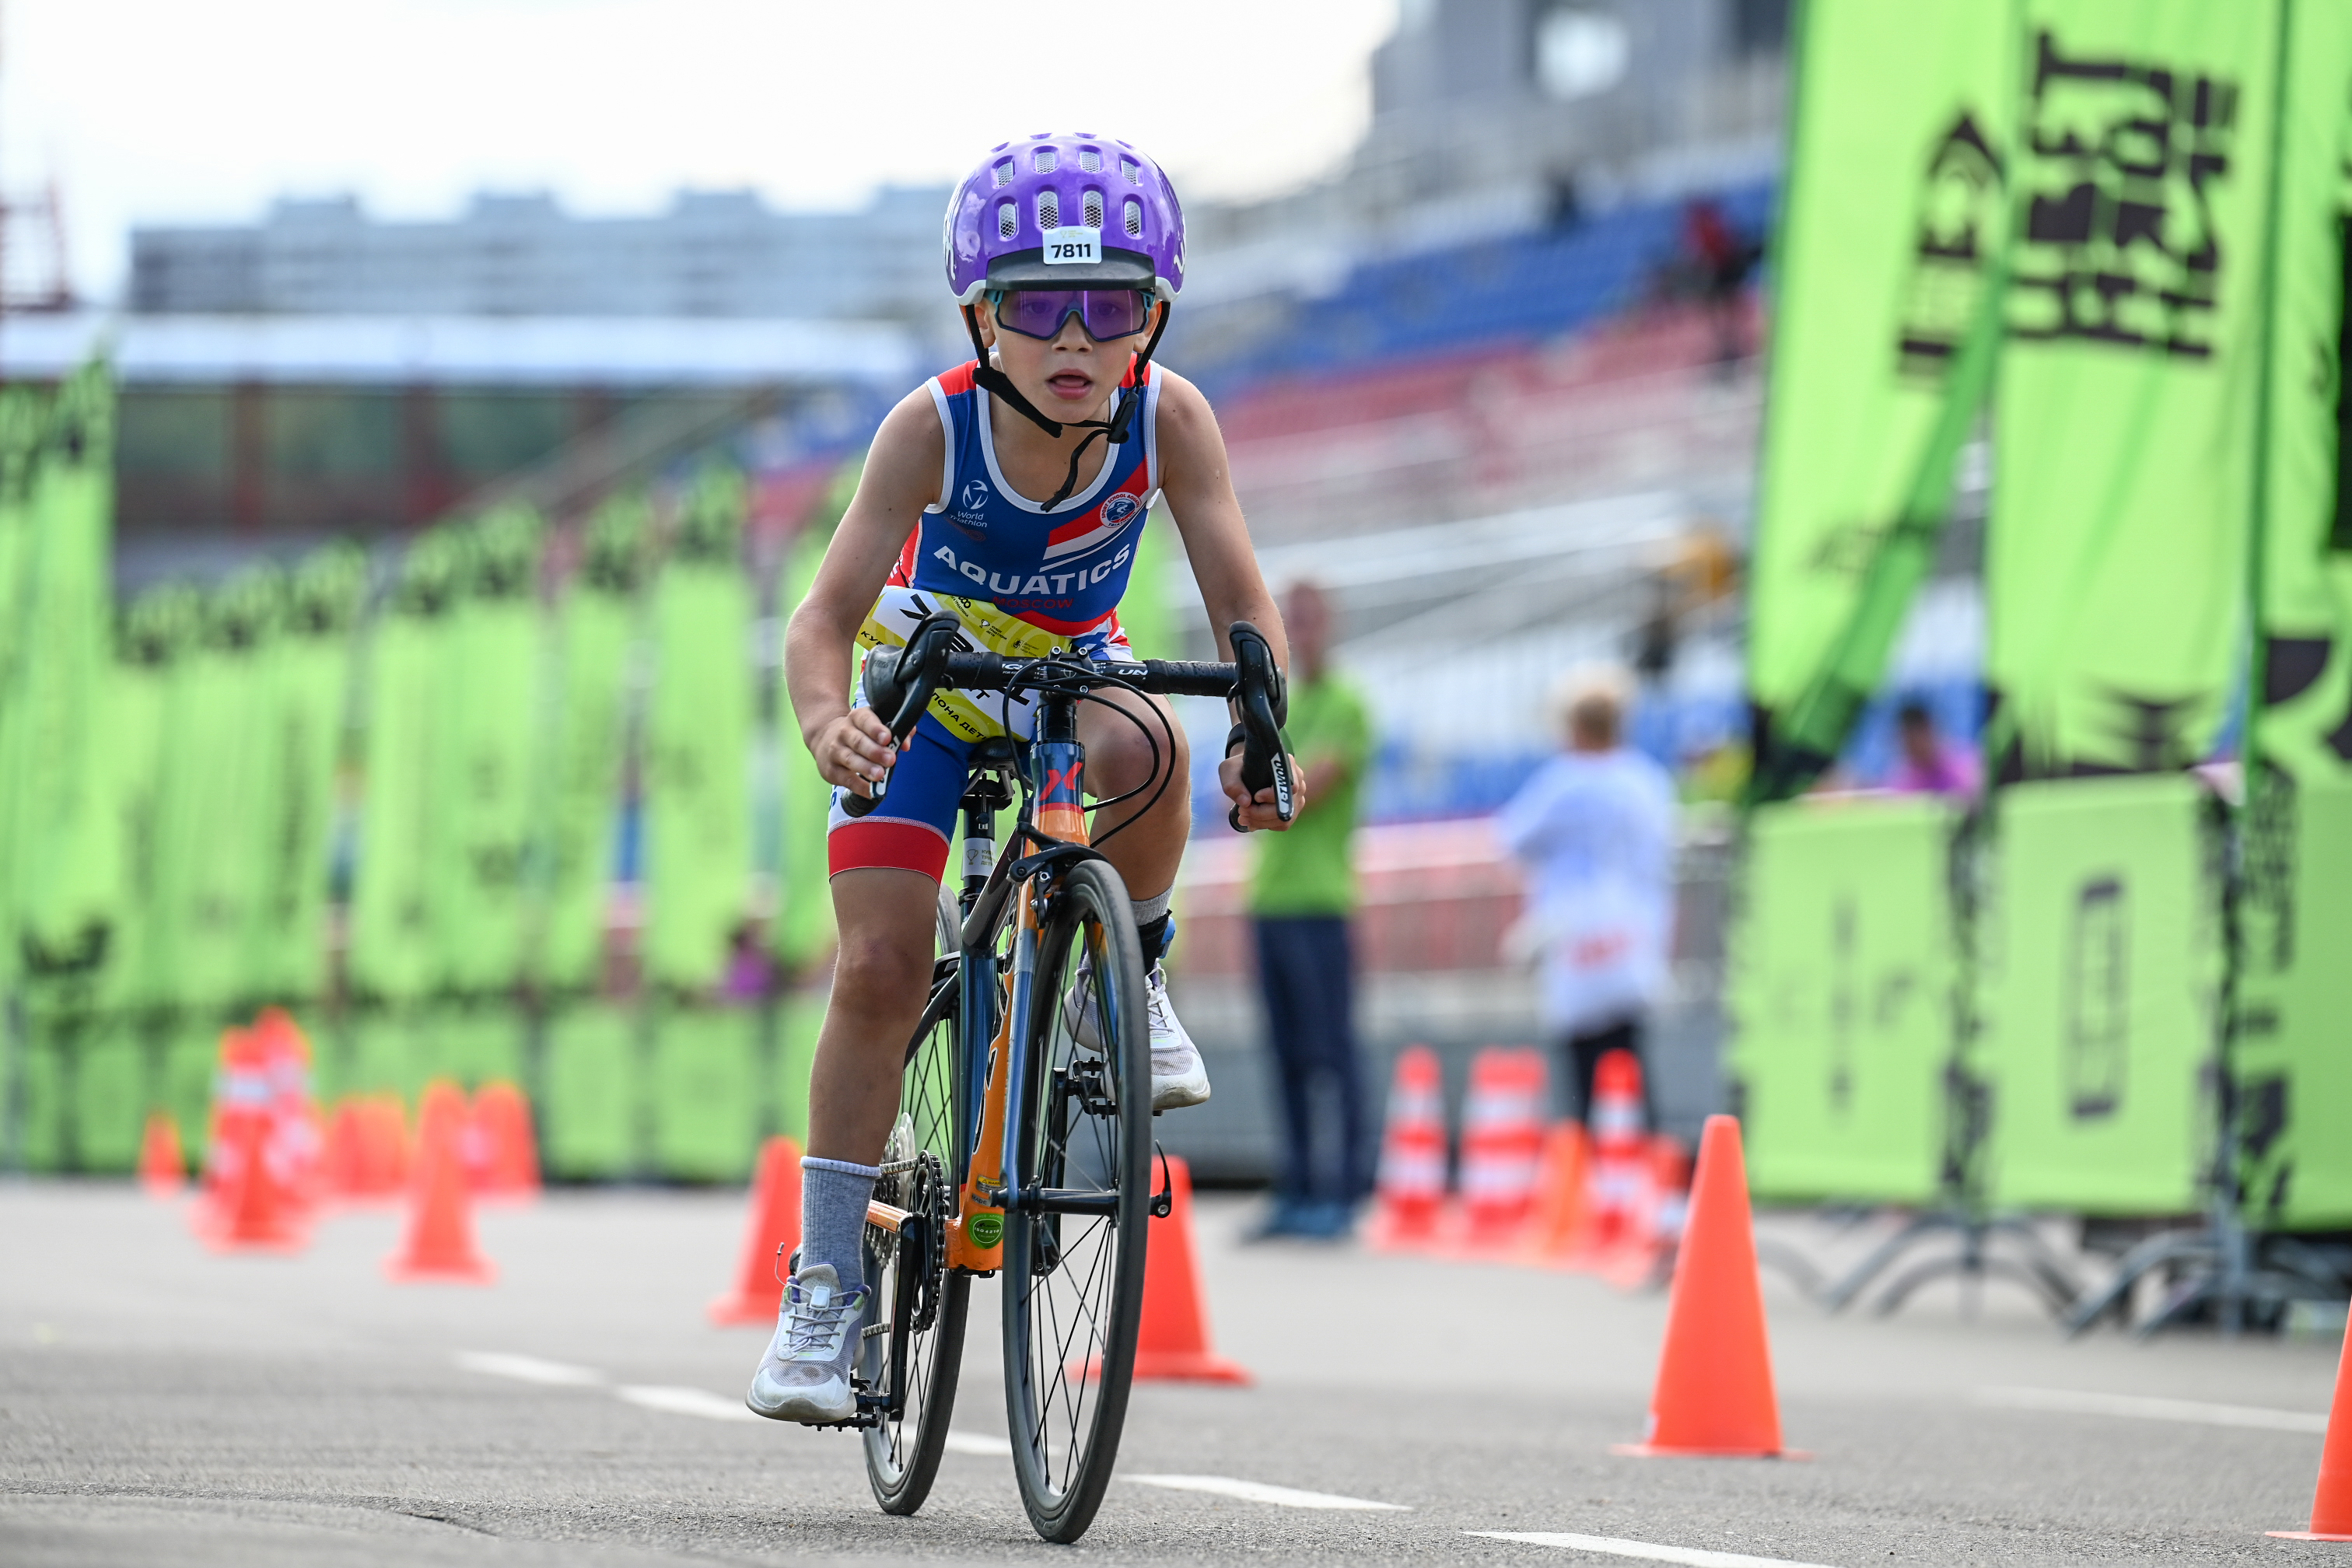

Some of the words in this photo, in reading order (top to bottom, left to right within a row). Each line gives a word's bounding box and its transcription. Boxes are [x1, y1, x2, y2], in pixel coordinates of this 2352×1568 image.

[1051, 243, 1091, 259] 7811
[1108, 493, 1127, 504] SCHOOL
[950, 514, 988, 528] Triathlon
[957, 510, 985, 521] World
[933, 543, 1130, 596] AQUATICS
[992, 596, 1074, 610] MOSCOW
[971, 1194, 988, 1206] MADE
